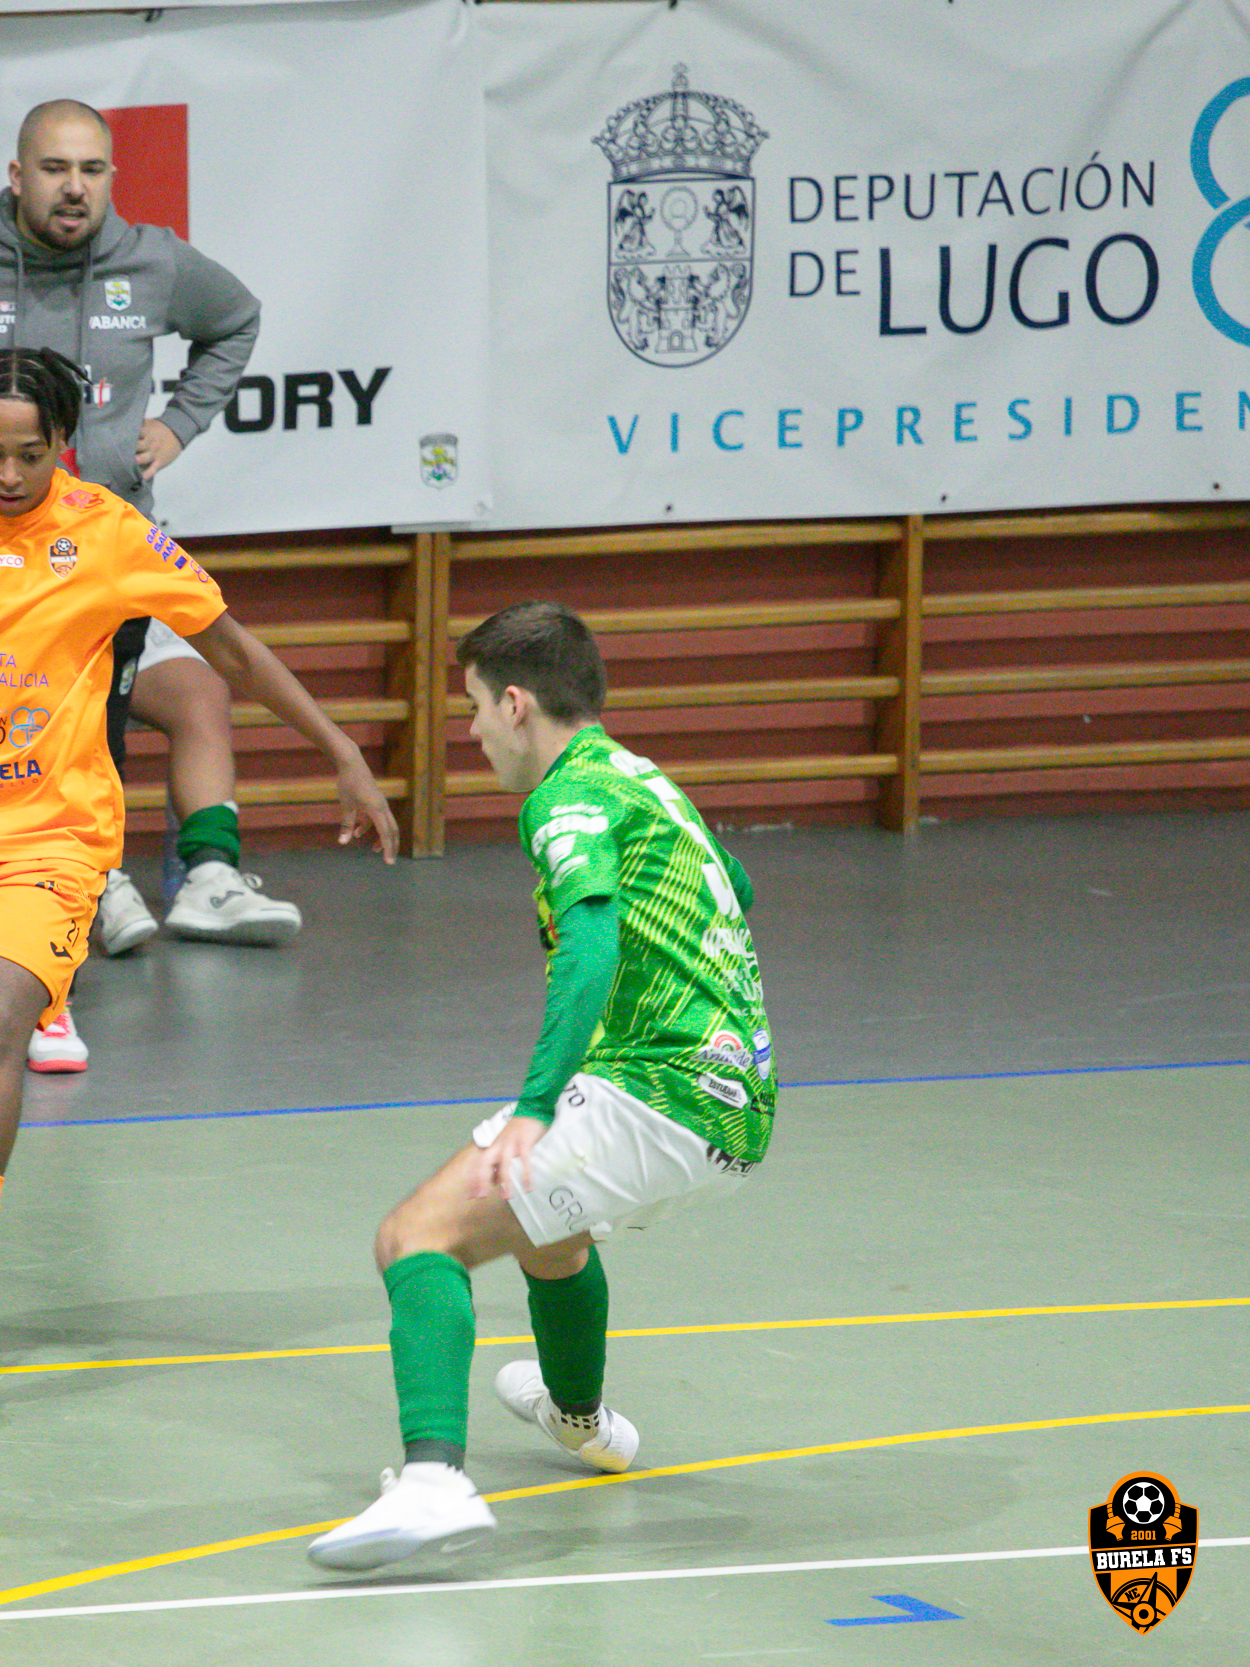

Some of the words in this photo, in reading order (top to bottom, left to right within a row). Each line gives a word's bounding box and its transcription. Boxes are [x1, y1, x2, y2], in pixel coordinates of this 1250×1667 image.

[789, 151, 1155, 224] DEPUTACIÓN
[789, 250, 861, 298] DE
[879, 233, 1160, 337] LUGO
